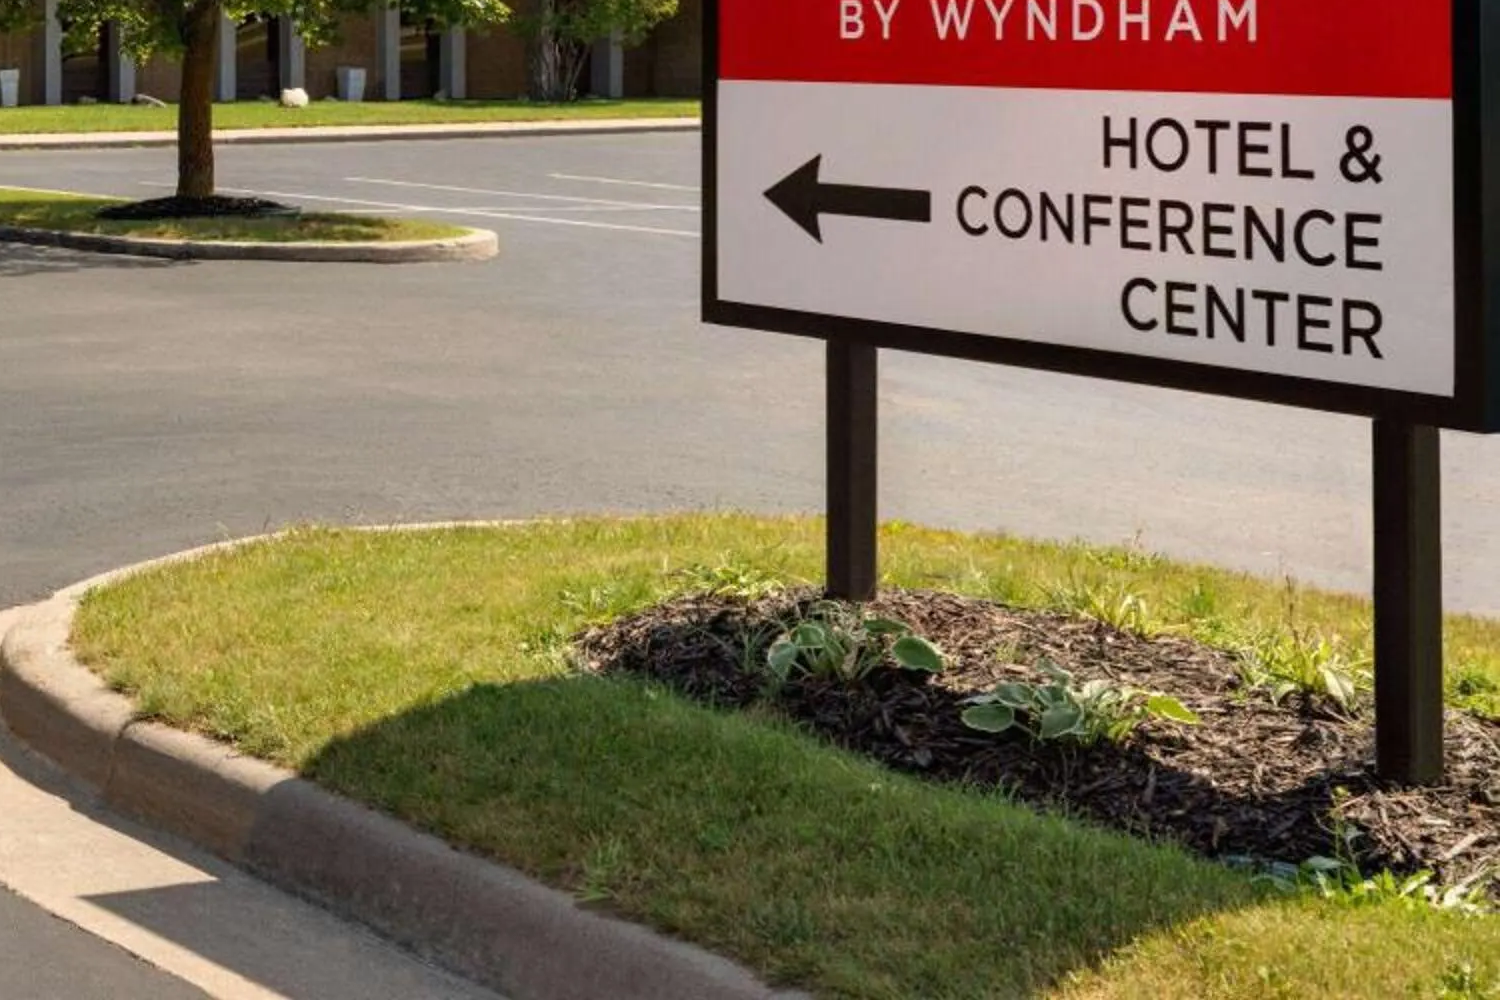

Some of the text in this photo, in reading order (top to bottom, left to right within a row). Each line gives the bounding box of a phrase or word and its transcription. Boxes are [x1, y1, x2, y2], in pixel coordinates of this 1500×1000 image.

[841, 0, 899, 39] BY
[1104, 116, 1382, 184] HOTEL &
[956, 185, 1383, 271] CONFERENCE
[1120, 277, 1384, 359] CENTER
